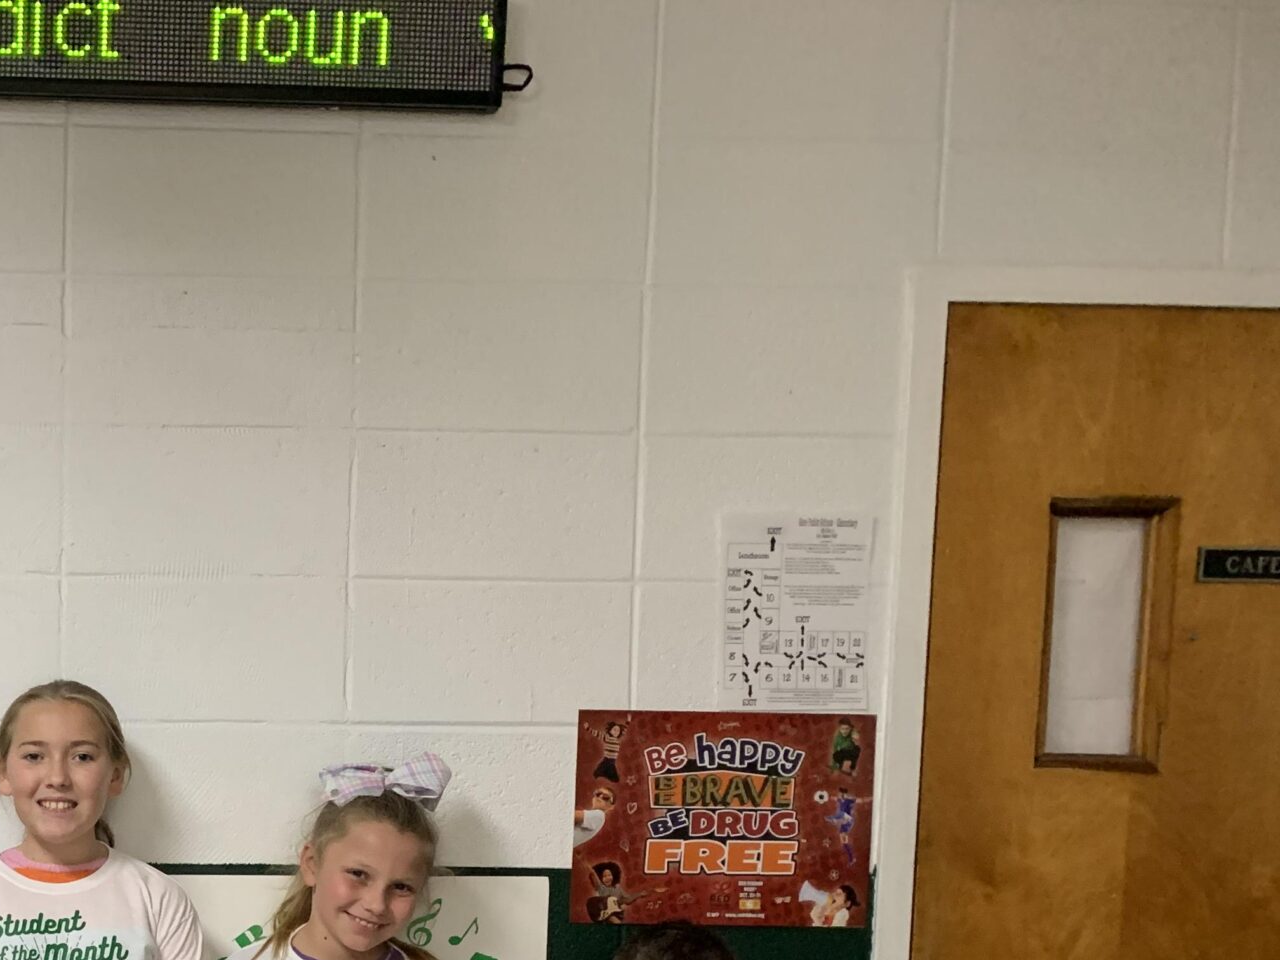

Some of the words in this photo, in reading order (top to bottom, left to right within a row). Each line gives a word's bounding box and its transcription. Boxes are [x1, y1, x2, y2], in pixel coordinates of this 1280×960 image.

[209, 6, 389, 65] noun
[644, 742, 688, 776] Be
[694, 732, 805, 776] happy
[682, 775, 792, 807] BRAVE
[648, 808, 689, 837] BE
[689, 809, 799, 838] DRUG
[644, 838, 799, 875] FREE
